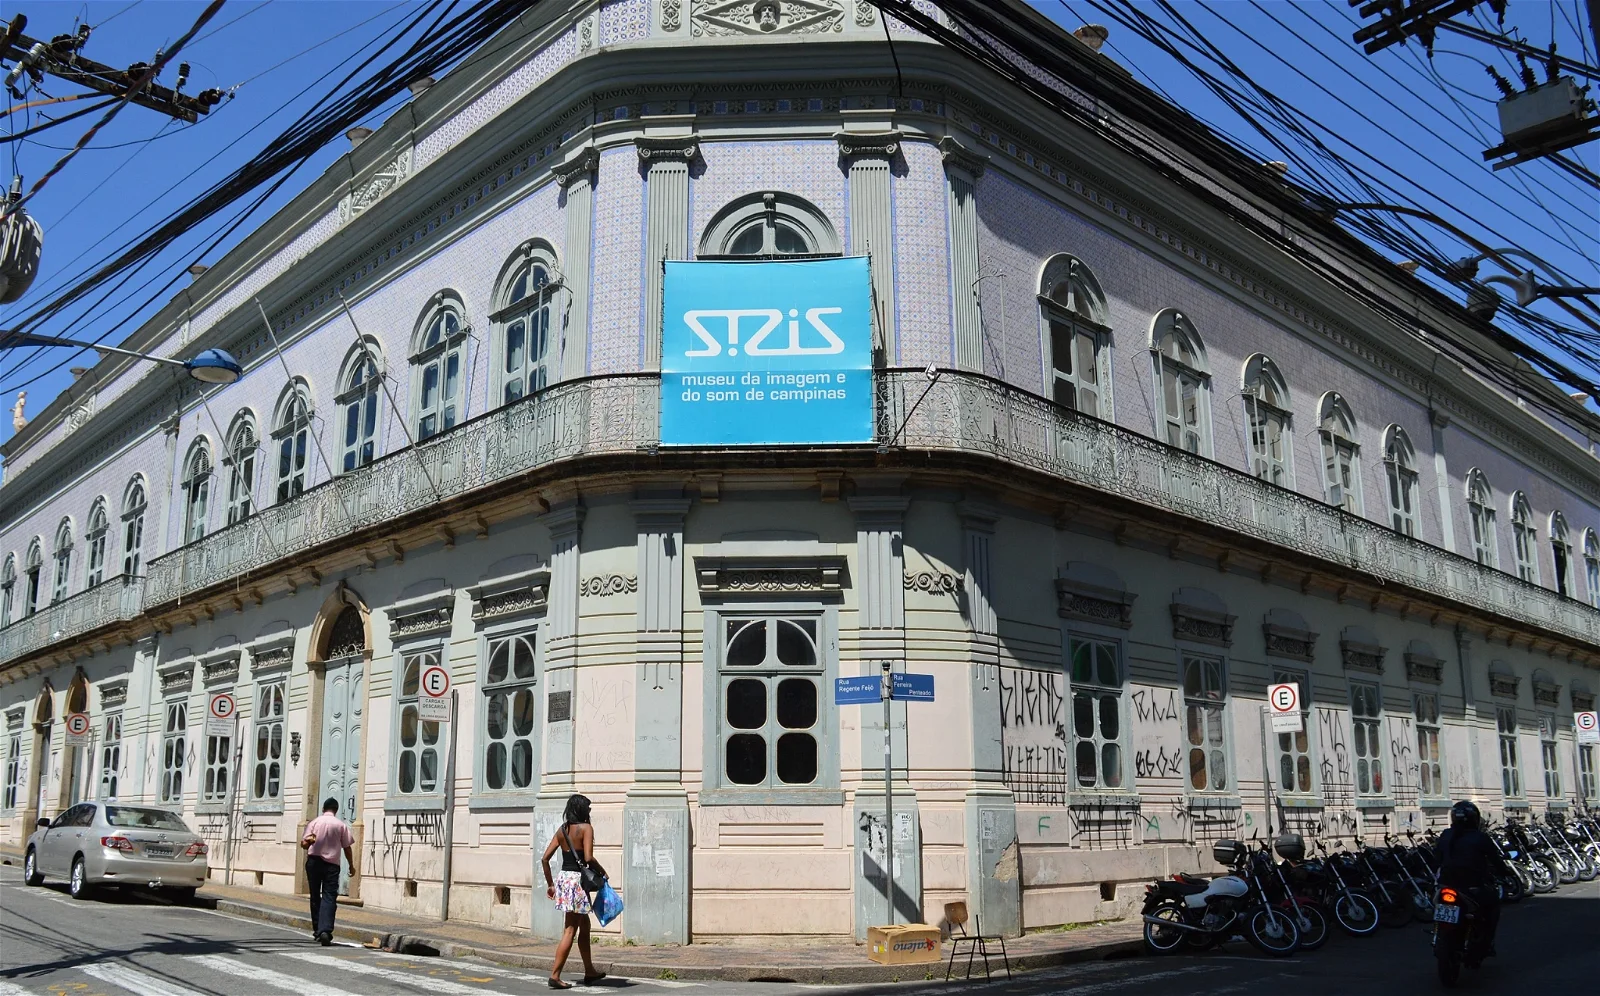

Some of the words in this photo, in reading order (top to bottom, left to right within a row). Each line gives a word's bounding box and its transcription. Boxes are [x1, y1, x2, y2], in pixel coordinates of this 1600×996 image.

[682, 373, 735, 386] museu
[740, 372, 761, 386] da
[766, 371, 831, 388] imagem
[836, 372, 846, 383] e
[681, 388, 701, 402] do
[706, 390, 740, 401] som
[745, 387, 764, 400] de
[770, 386, 846, 403] campinas
[431, 674, 439, 689] E
[219, 700, 226, 712] E
[1280, 692, 1288, 705] E
[74, 719, 82, 730] E
[1583, 716, 1590, 725] E
[1038, 816, 1051, 836] F
[1146, 815, 1161, 840] A
